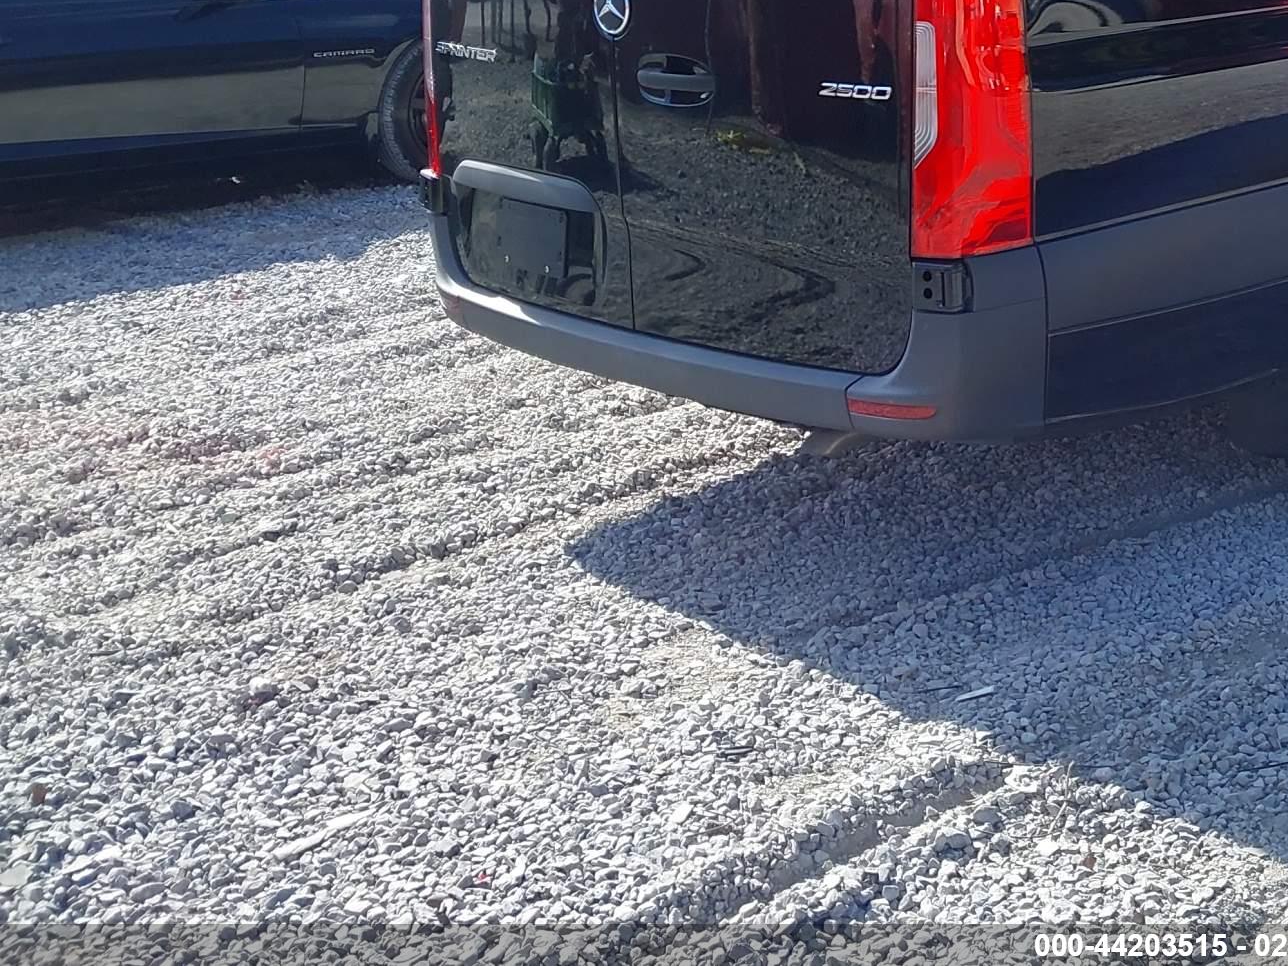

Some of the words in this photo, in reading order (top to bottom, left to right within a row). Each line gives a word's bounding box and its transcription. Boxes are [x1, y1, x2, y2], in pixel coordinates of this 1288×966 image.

[313, 48, 375, 58] CAMARO
[435, 41, 497, 62] SPRINTER
[819, 82, 892, 100] 2500
